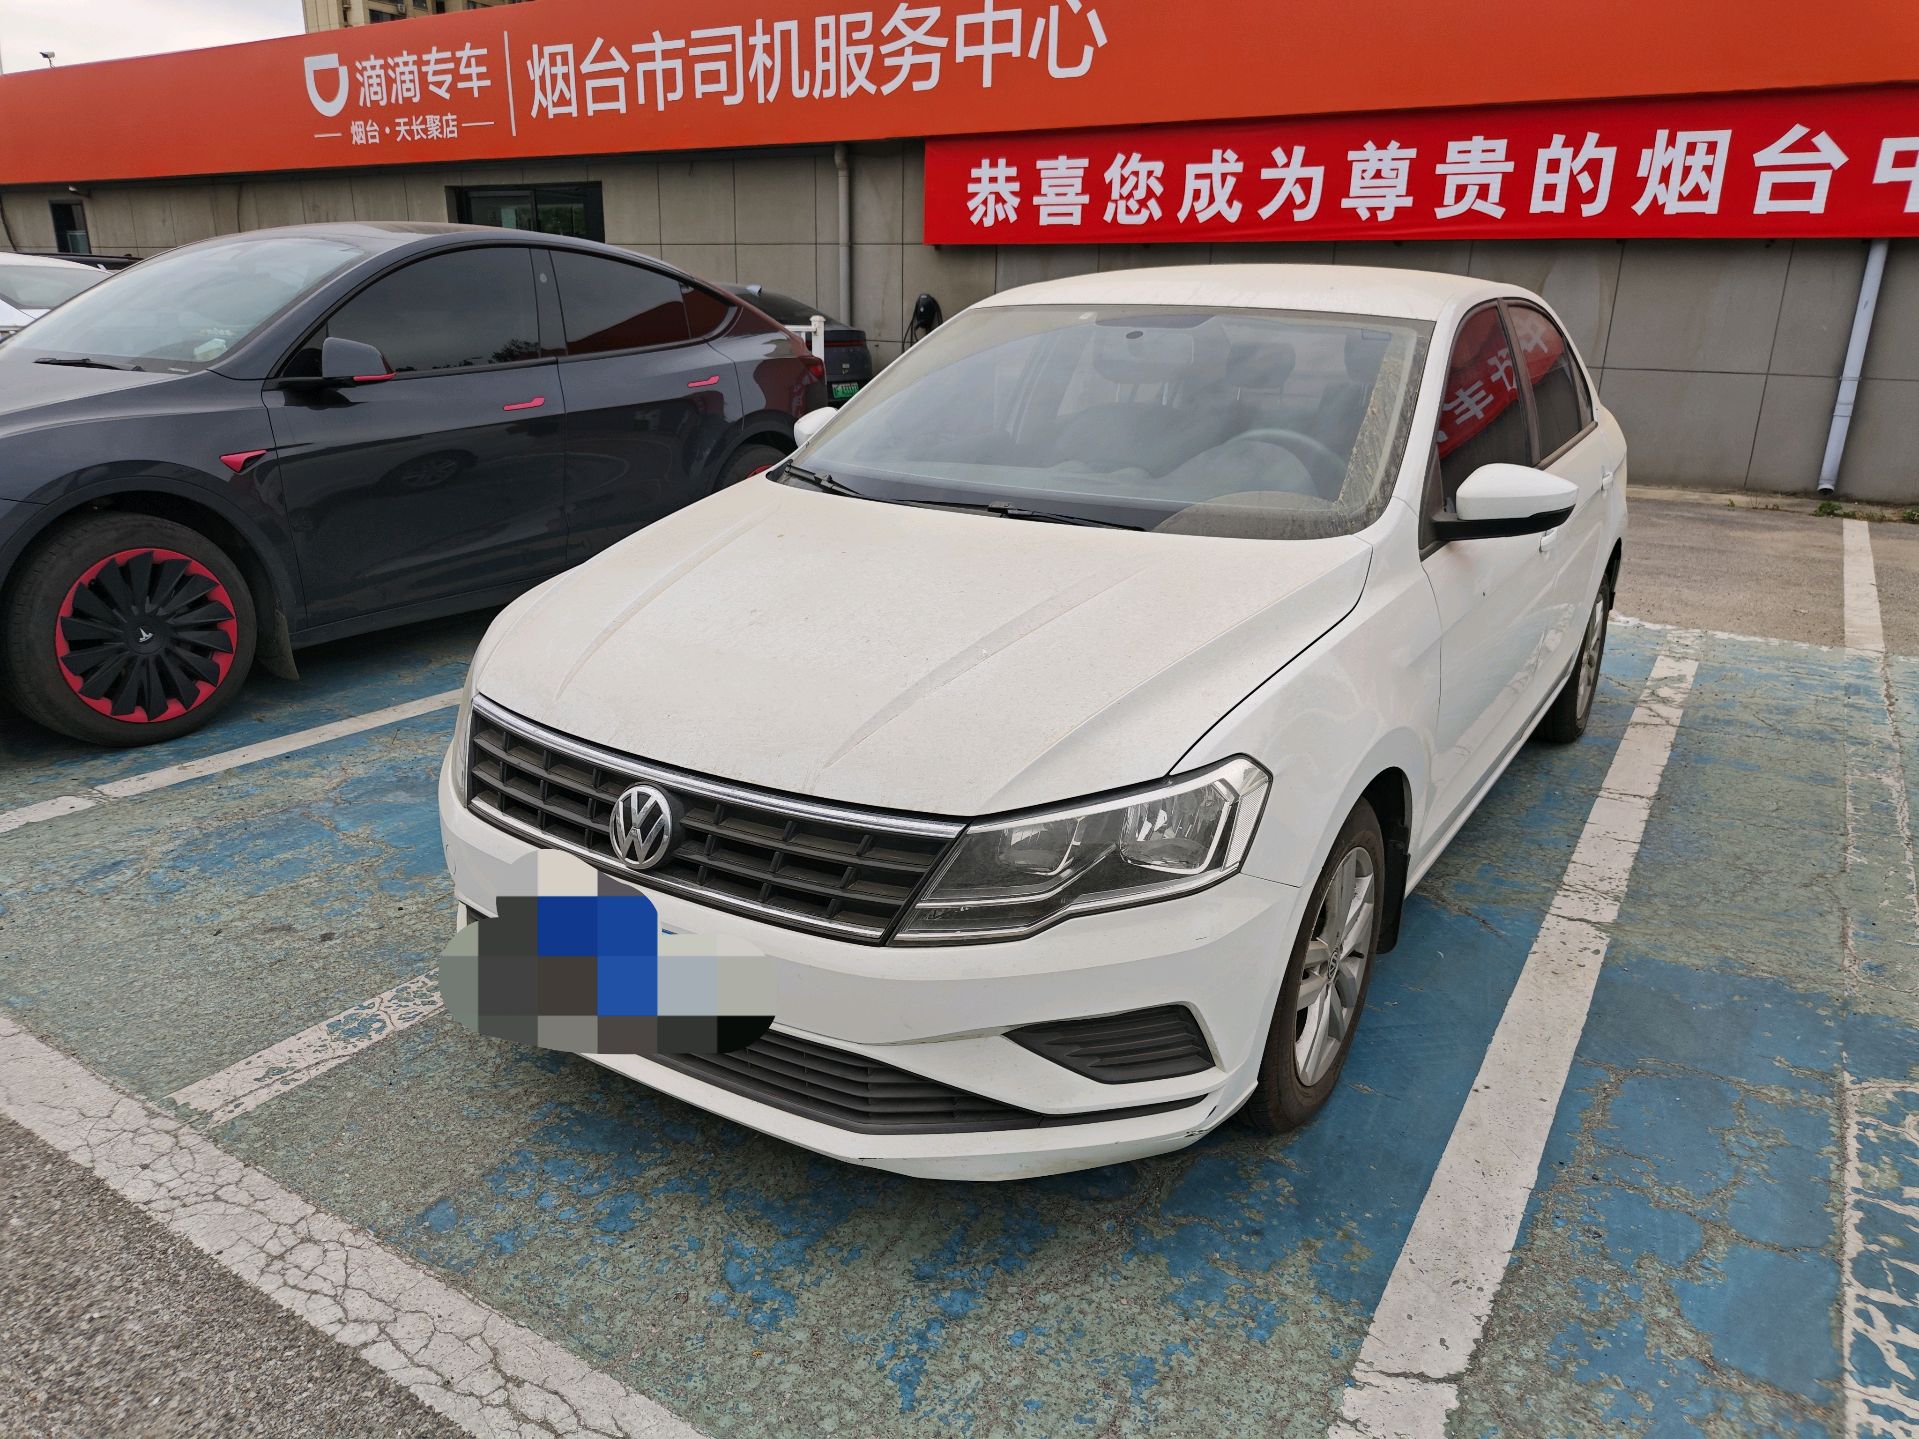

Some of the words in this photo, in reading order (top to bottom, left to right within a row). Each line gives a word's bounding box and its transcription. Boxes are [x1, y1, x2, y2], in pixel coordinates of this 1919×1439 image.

[355, 42, 492, 108] 滴滴专车
[527, 0, 1107, 119] 烟台市司机服务中心
